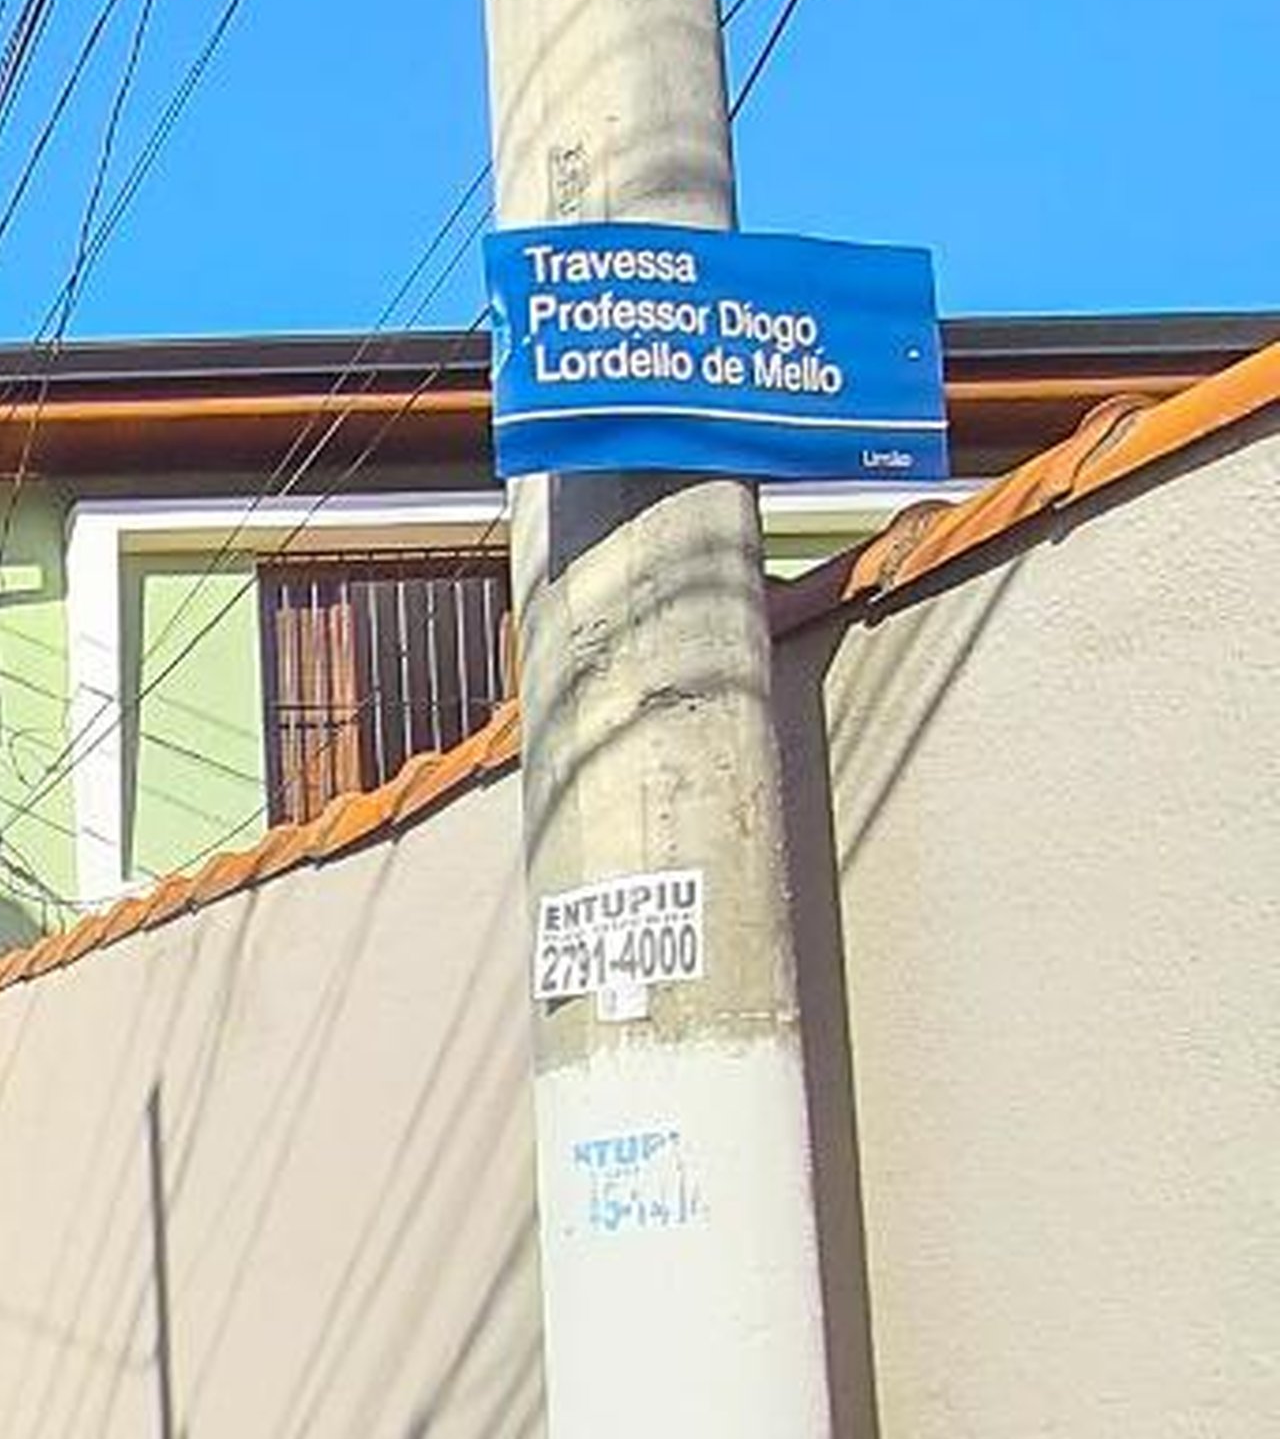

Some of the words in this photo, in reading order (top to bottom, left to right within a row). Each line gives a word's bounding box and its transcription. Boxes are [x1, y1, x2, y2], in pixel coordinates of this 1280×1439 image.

[523, 245, 697, 283] Travessa
[528, 291, 711, 335] Professor
[719, 300, 817, 353] Diogo
[535, 341, 693, 383] Lordello
[702, 347, 745, 384] de
[753, 349, 843, 393] Mello
